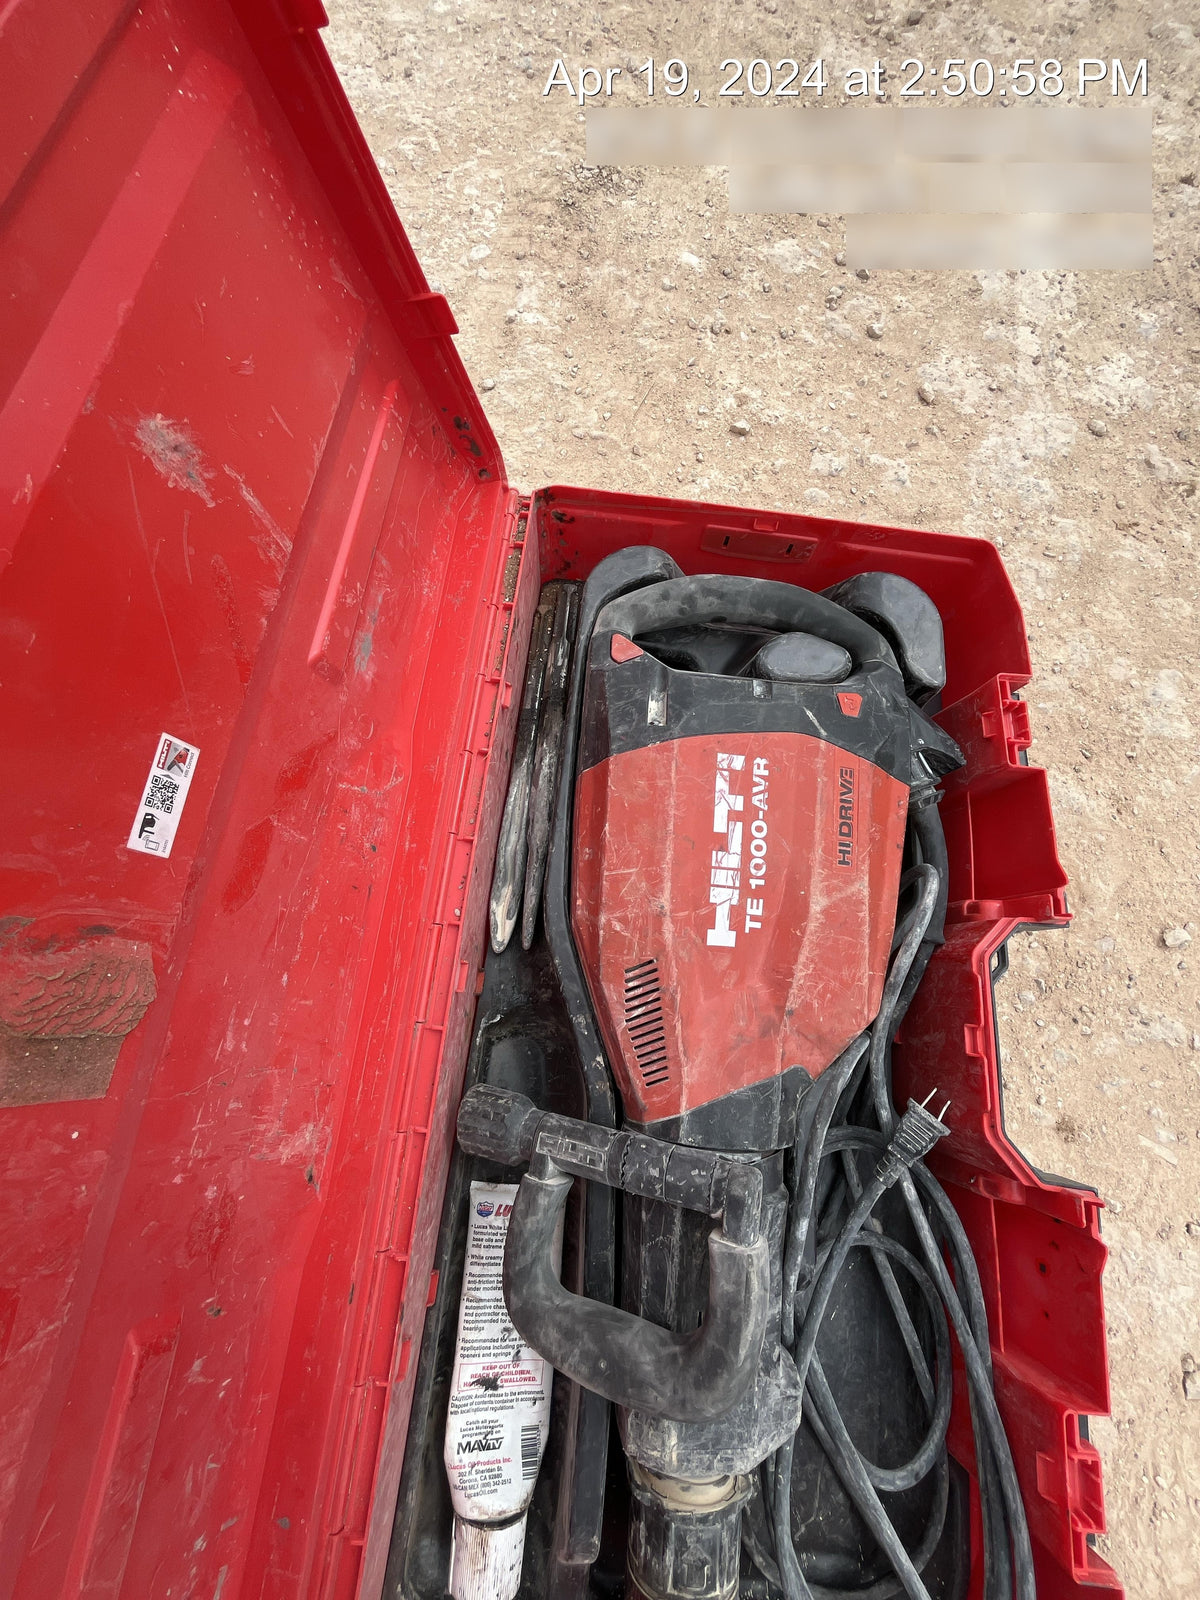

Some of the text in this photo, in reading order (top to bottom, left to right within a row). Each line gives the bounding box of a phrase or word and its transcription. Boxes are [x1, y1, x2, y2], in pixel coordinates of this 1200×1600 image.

[158, 740, 171, 769] HILTI
[707, 753, 745, 947] HILTI
[745, 757, 770, 933] TE 1000-AVR
[473, 1229, 499, 1237] formulated
[492, 1343, 516, 1351] including
